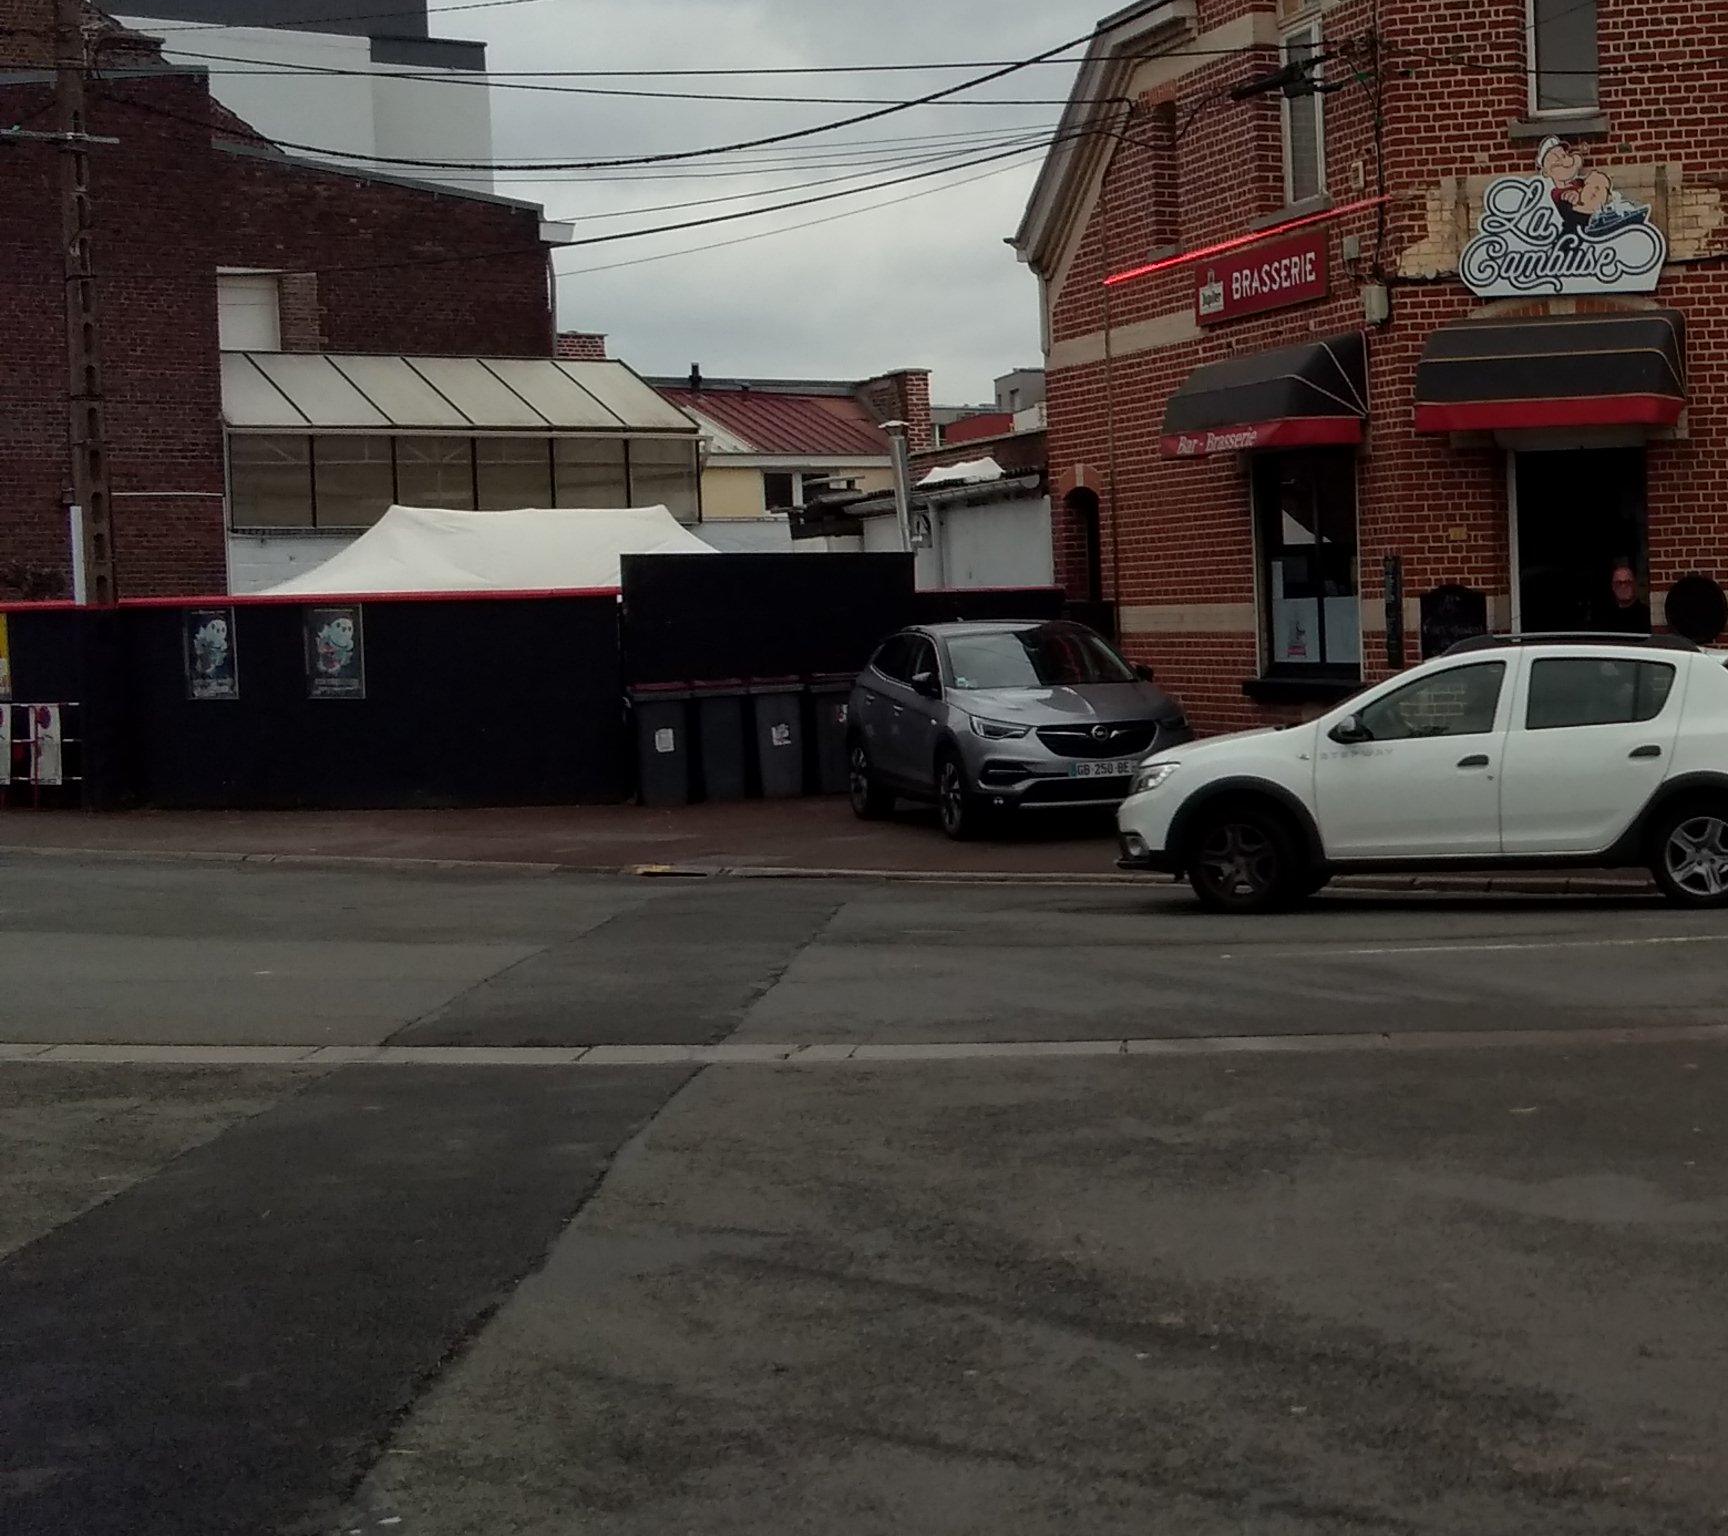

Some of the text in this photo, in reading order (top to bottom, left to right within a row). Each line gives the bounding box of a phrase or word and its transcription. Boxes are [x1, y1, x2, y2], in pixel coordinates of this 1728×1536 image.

[1481, 179, 1558, 245] La
[1231, 251, 1316, 301] BRASSERIE
[1176, 435, 1199, 455] Bar
[1205, 425, 1258, 453] Brasserie
